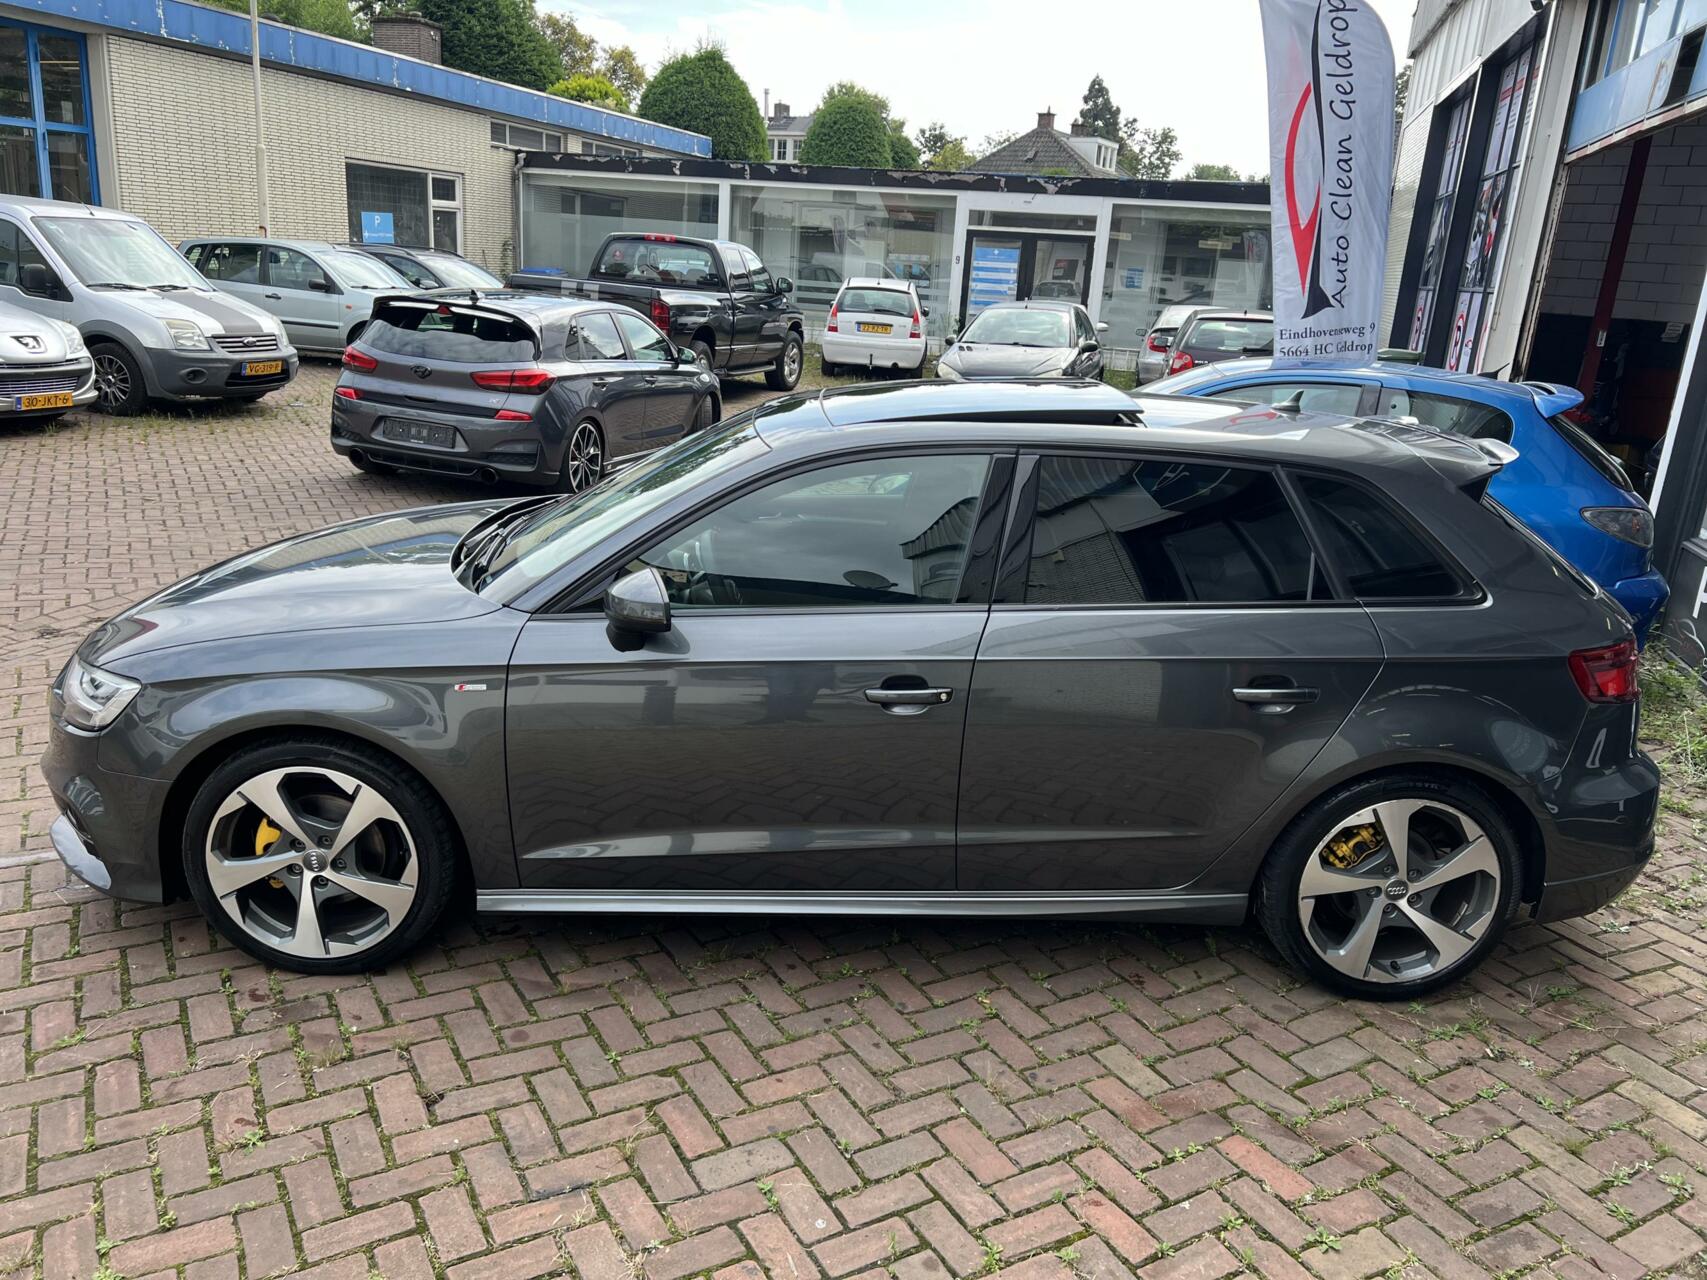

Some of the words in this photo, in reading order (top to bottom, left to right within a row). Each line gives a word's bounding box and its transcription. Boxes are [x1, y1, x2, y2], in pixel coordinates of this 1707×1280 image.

[1324, 0, 1358, 120] Geldrop
[1326, 135, 1353, 220] Clean
[374, 215, 381, 228] P
[955, 255, 961, 265] 9
[1331, 235, 1350, 308] Auto
[1369, 321, 1376, 336] 9
[1279, 345, 1310, 357] 5664
[1314, 343, 1333, 355] HC
[25, 395, 70, 408] 30-JKT-6
